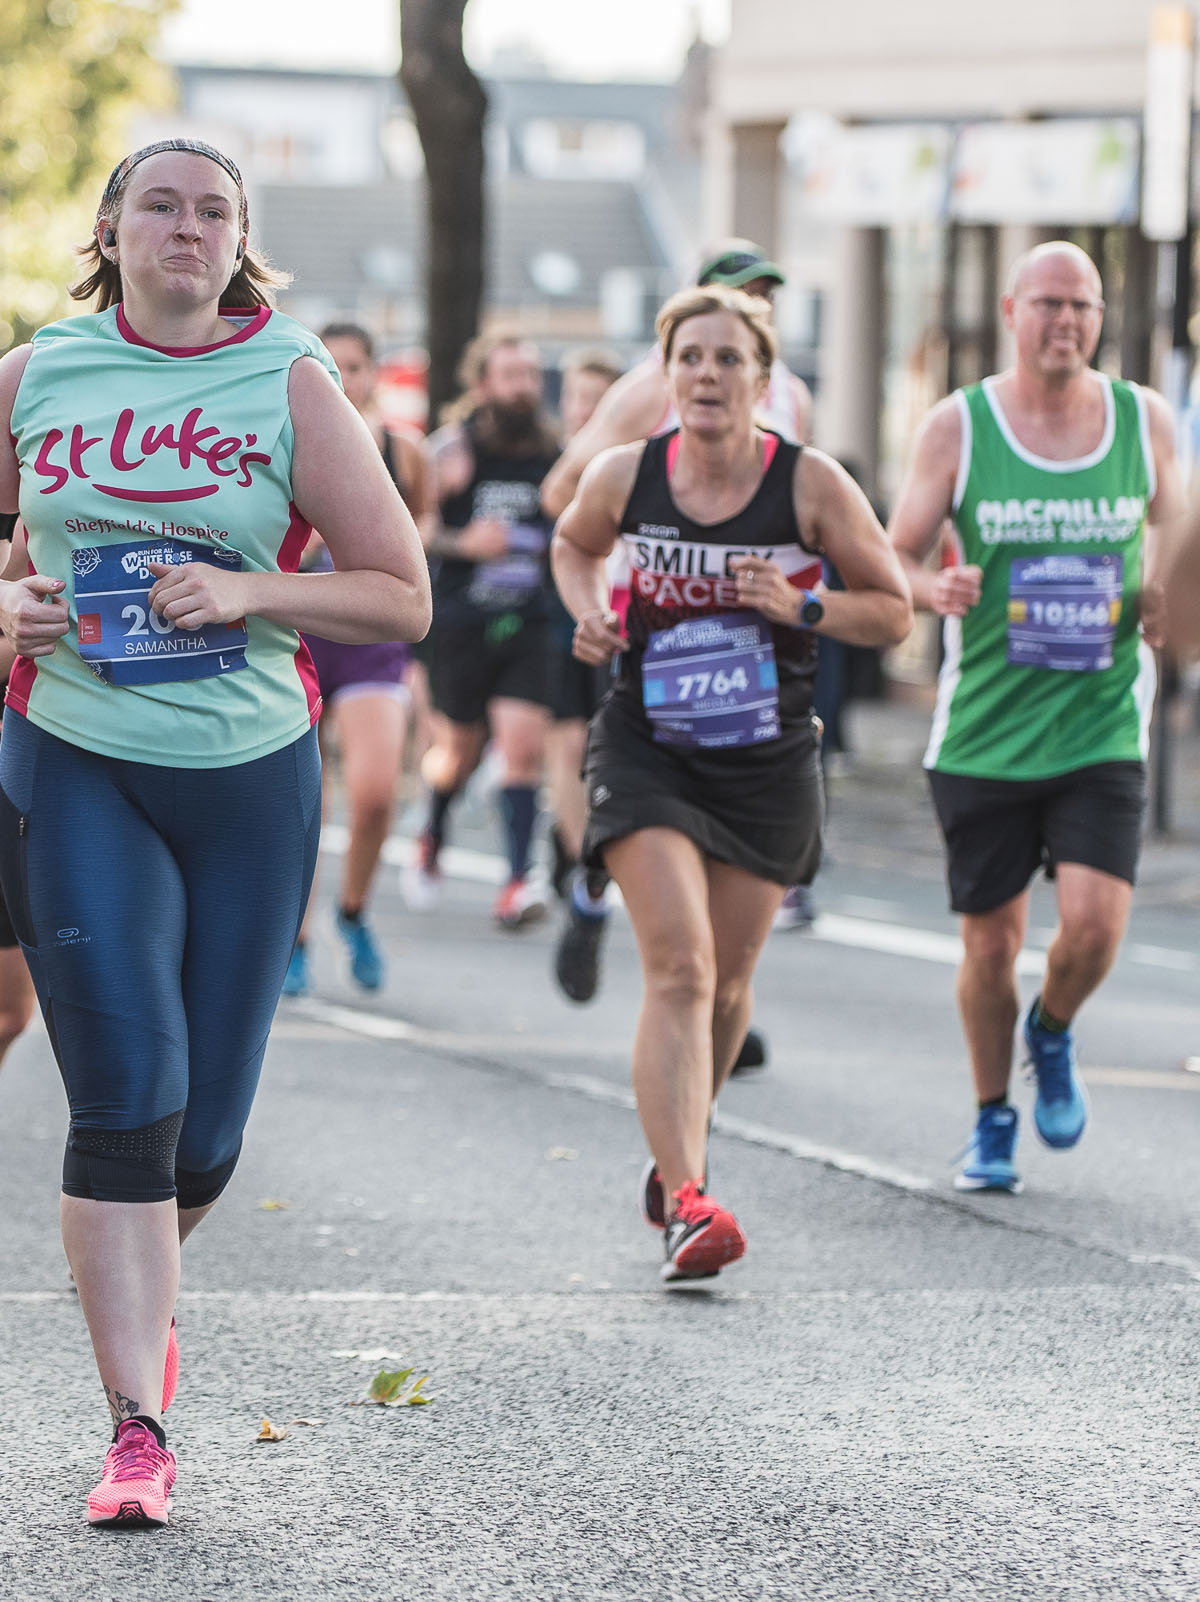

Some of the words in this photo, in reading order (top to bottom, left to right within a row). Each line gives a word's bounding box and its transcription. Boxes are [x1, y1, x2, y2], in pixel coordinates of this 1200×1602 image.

[34, 424, 104, 494] St
[110, 408, 271, 487] Luke's
[976, 497, 1145, 526] MACMILLAN
[64, 518, 156, 536] Sheffield's
[161, 521, 229, 541] Hospice
[125, 554, 163, 568] WHITE
[165, 550, 193, 564] ROSE
[124, 637, 208, 655] SAMANTHA
[219, 655, 230, 670] L
[676, 667, 749, 701] 7764
